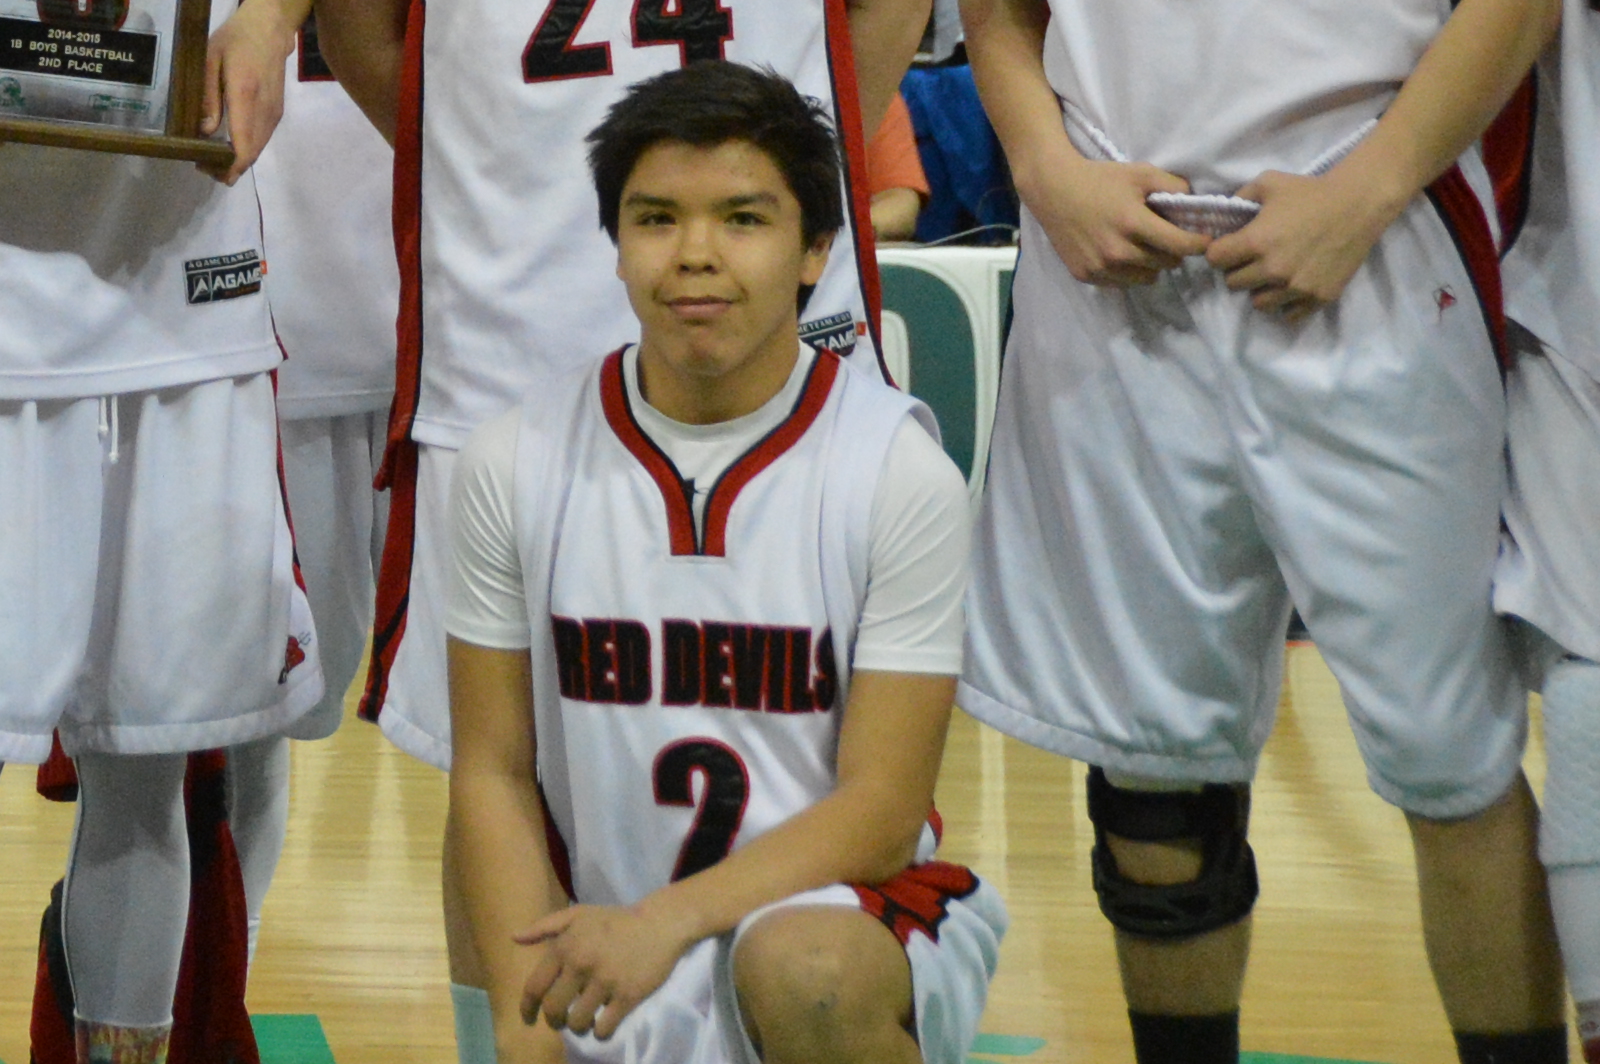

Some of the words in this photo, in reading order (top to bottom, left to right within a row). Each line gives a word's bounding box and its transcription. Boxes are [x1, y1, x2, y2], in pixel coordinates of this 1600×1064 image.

[29, 40, 58, 54] BOYS
[64, 44, 135, 63] BASKETBALL
[38, 56, 62, 68] 2ND
[67, 59, 104, 73] PLACE
[213, 267, 263, 291] AGAME
[550, 614, 652, 706] RED
[661, 618, 838, 715] DEVILS
[652, 736, 750, 883] 2
